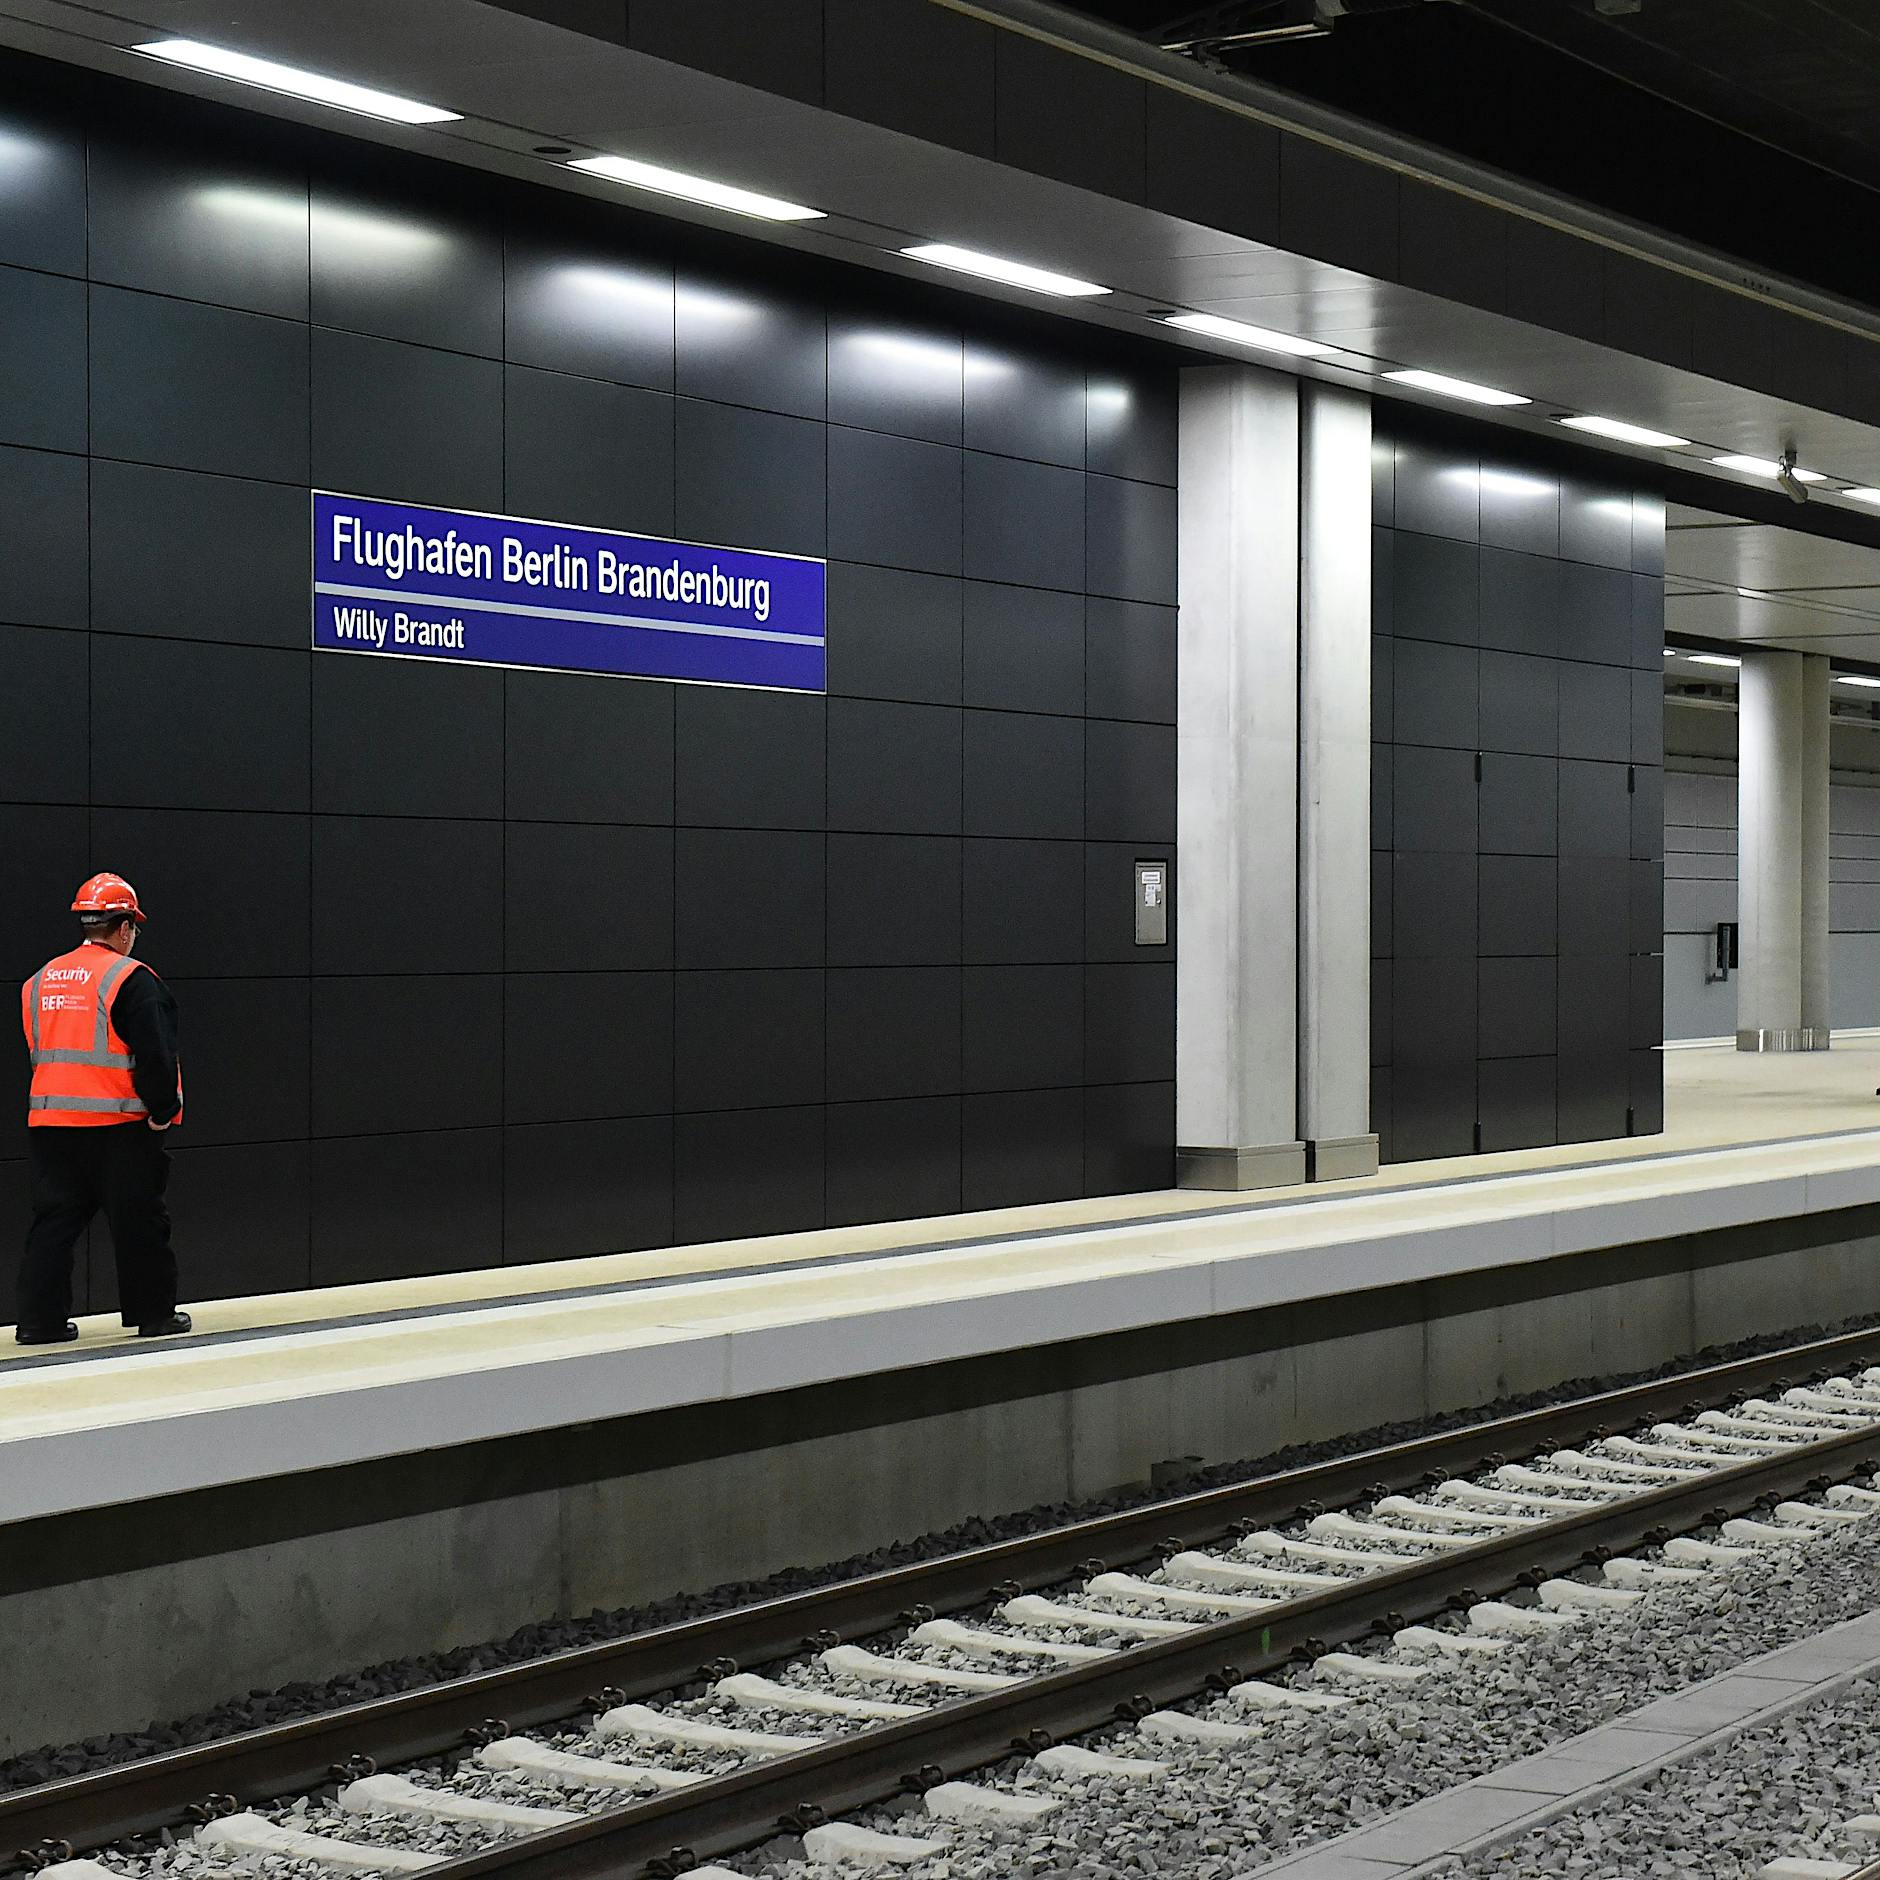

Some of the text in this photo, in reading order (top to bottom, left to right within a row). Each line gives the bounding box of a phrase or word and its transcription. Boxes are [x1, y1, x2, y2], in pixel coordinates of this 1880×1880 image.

[332, 515, 769, 621] Flughafen Berlin Brandenburg
[333, 606, 465, 649] Willy Brandt
[45, 966, 92, 985] Security
[42, 995, 65, 1011] BER
